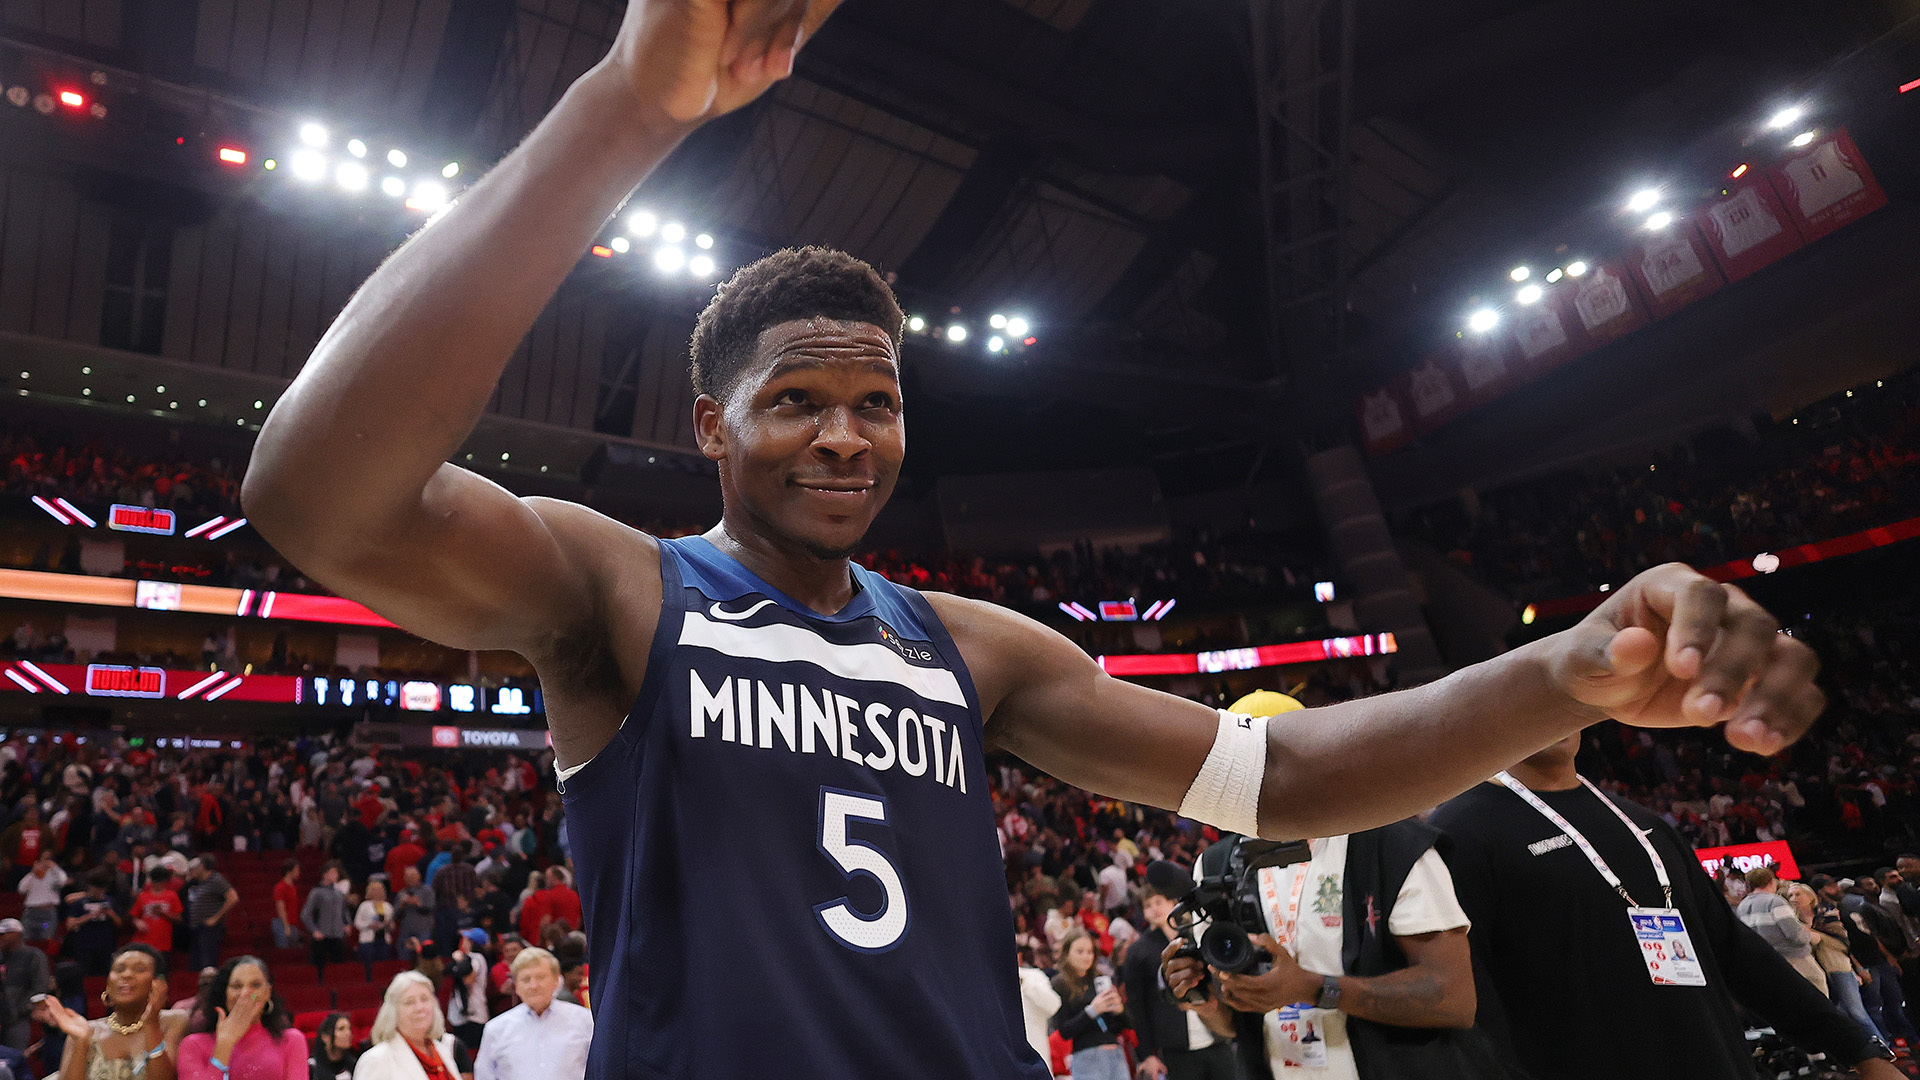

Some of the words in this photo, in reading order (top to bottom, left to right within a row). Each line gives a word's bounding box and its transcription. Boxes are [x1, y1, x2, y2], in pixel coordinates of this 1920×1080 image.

[887, 633, 932, 661] sezzle
[462, 730, 520, 746] TOYOTA
[689, 668, 967, 795] MINNESOTA
[815, 788, 910, 952] 5
